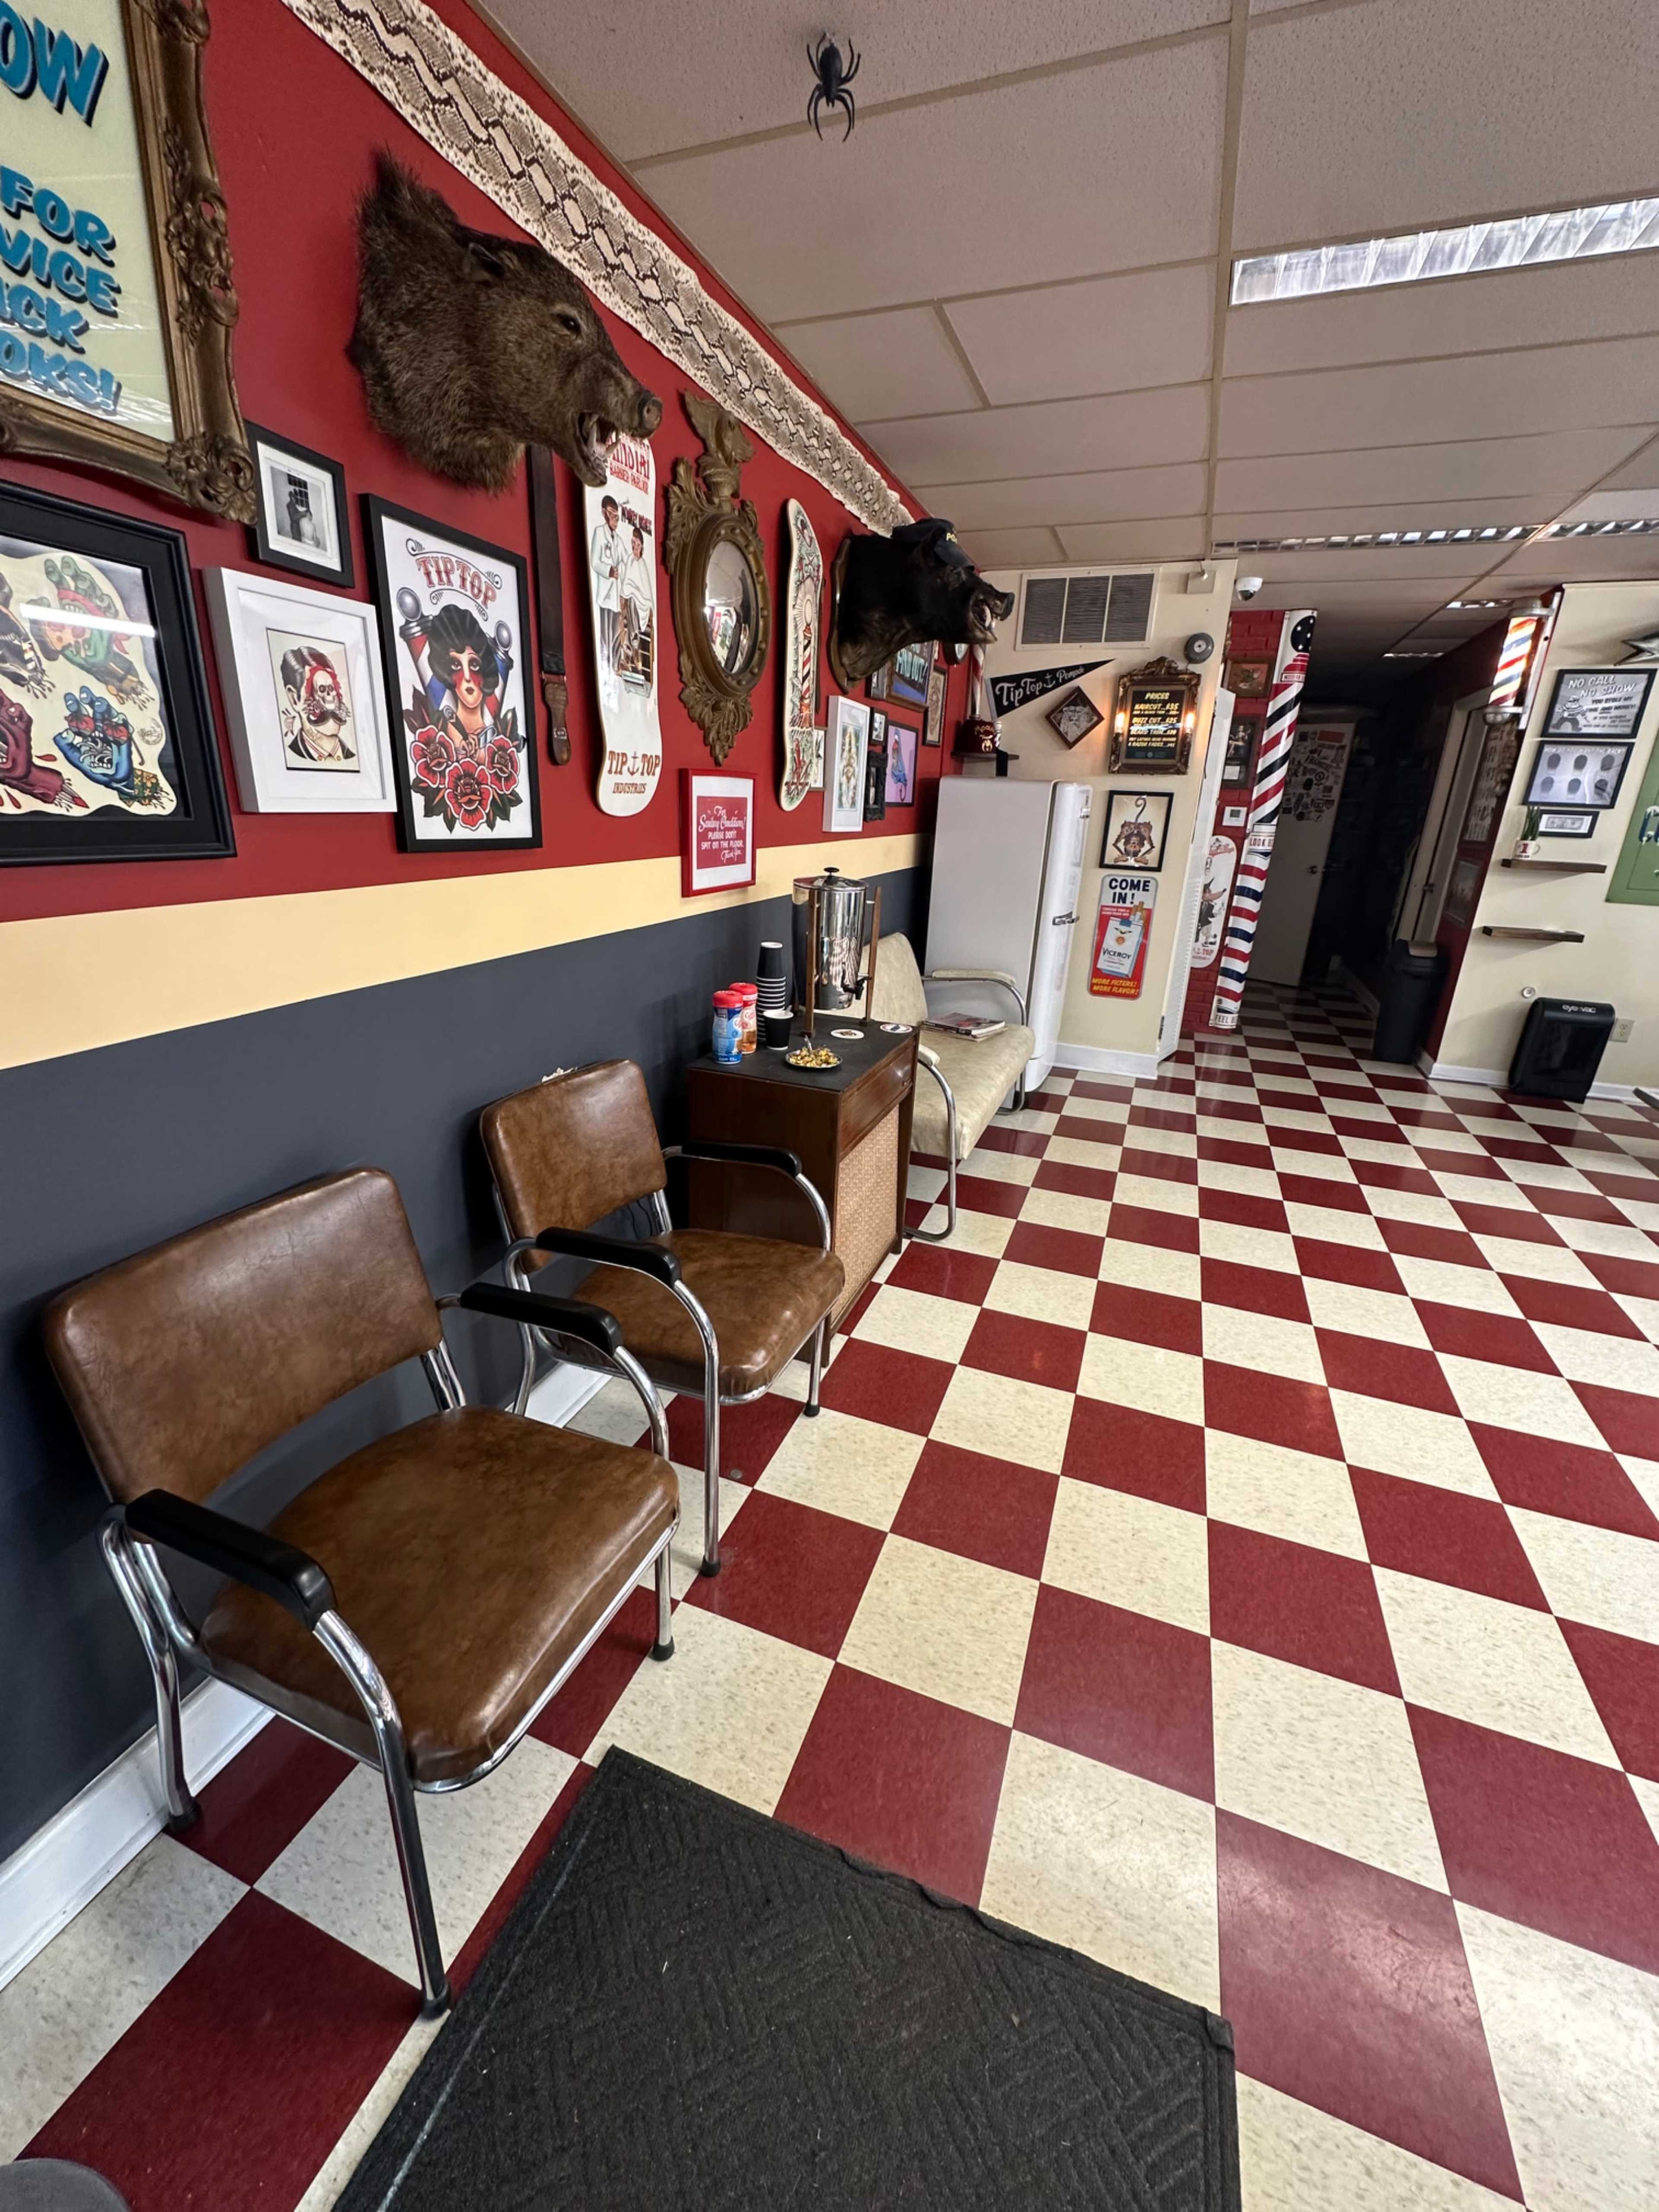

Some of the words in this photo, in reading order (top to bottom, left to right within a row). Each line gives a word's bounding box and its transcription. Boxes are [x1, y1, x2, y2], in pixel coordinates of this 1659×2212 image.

[0, 165, 117, 268] FOR
[416, 556, 455, 588] TIP
[455, 560, 496, 609] TOP
[1568, 678, 1585, 688] NO
[1588, 675, 1616, 686] CALL
[995, 683, 1023, 706] Tip
[1021, 678, 1042, 695] Top
[1580, 688, 1597, 698] NO
[1601, 683, 1636, 696] SHOW
[608, 750, 628, 775] TIP
[640, 753, 661, 776] TOP
[708, 831, 724, 840] PLEASE
[701, 841, 711, 850] SPIT
[712, 841, 719, 849] ON
[720, 840, 728, 849] THE
[1109, 877, 1150, 892] COME
[1103, 947, 1131, 960] VICEROY
[1112, 987, 1139, 995] FLAVOR!
